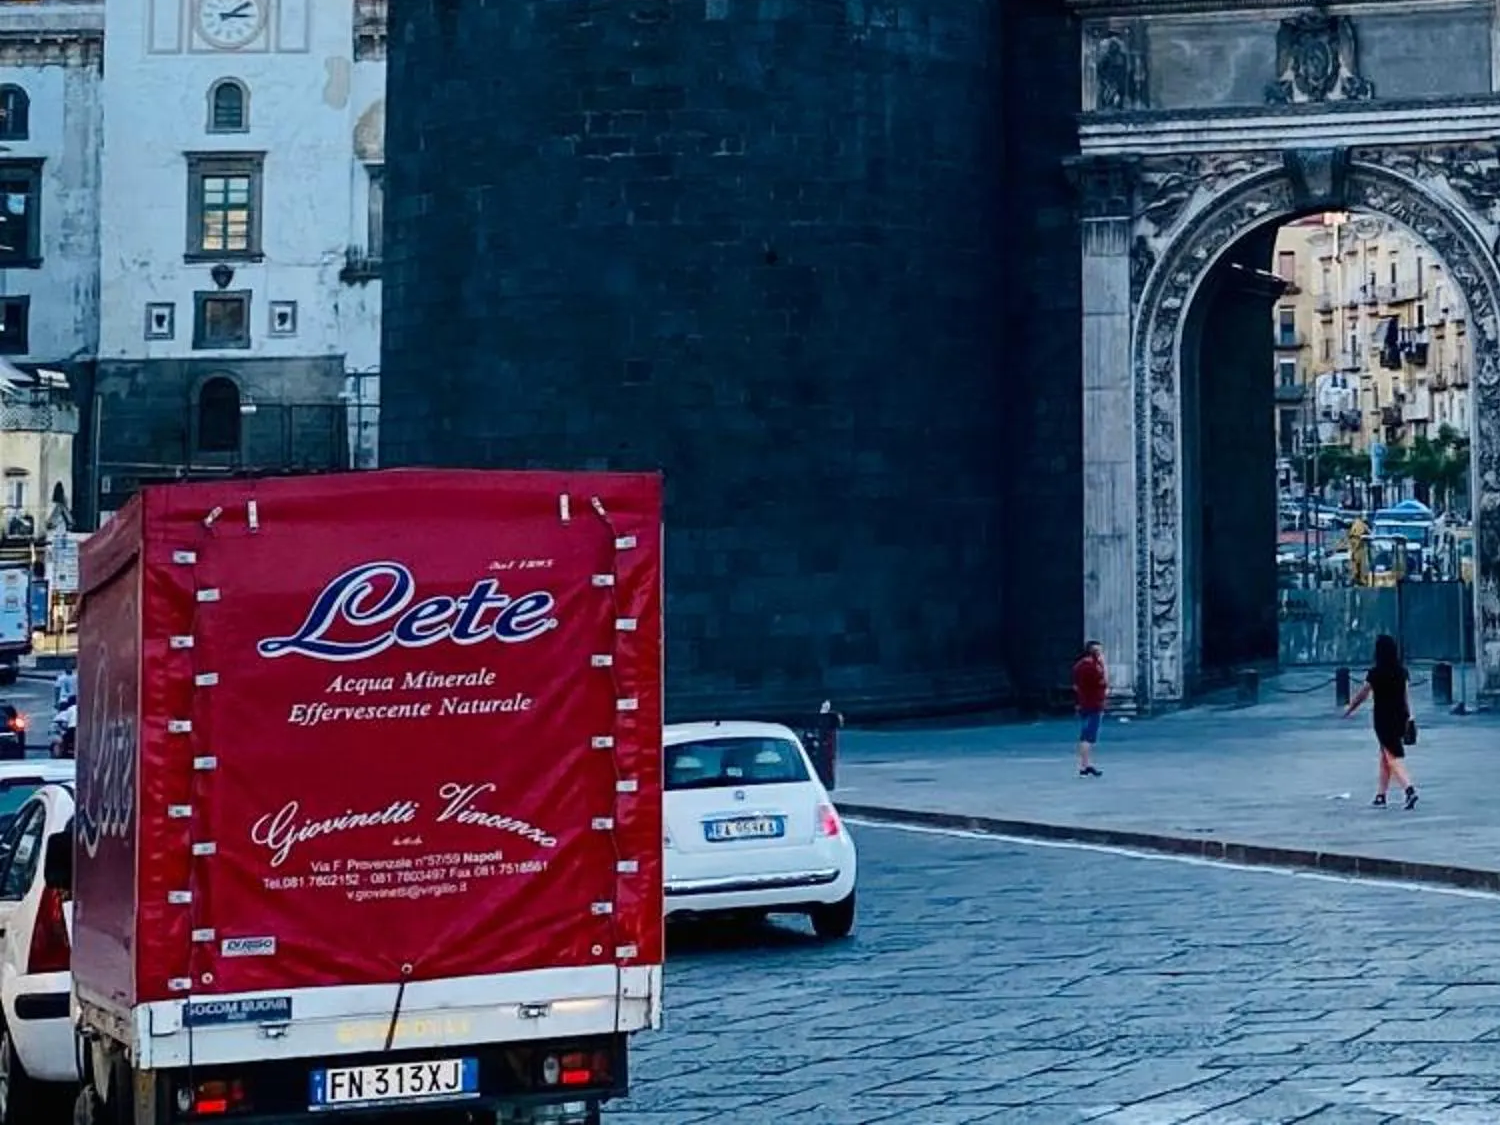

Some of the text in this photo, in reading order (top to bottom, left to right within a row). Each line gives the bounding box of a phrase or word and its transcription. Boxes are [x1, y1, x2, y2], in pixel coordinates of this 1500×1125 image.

[257, 561, 559, 660] Lete
[326, 668, 497, 695] Acqua Minerale
[288, 693, 532, 725] Effervescente Naturale
[251, 782, 558, 867] Giovinetti Vincenzo
[311, 861, 331, 873] Via
[463, 850, 503, 864] Napoli
[331, 1071, 363, 1100] FN
[375, 1062, 460, 1095] 313XJ
